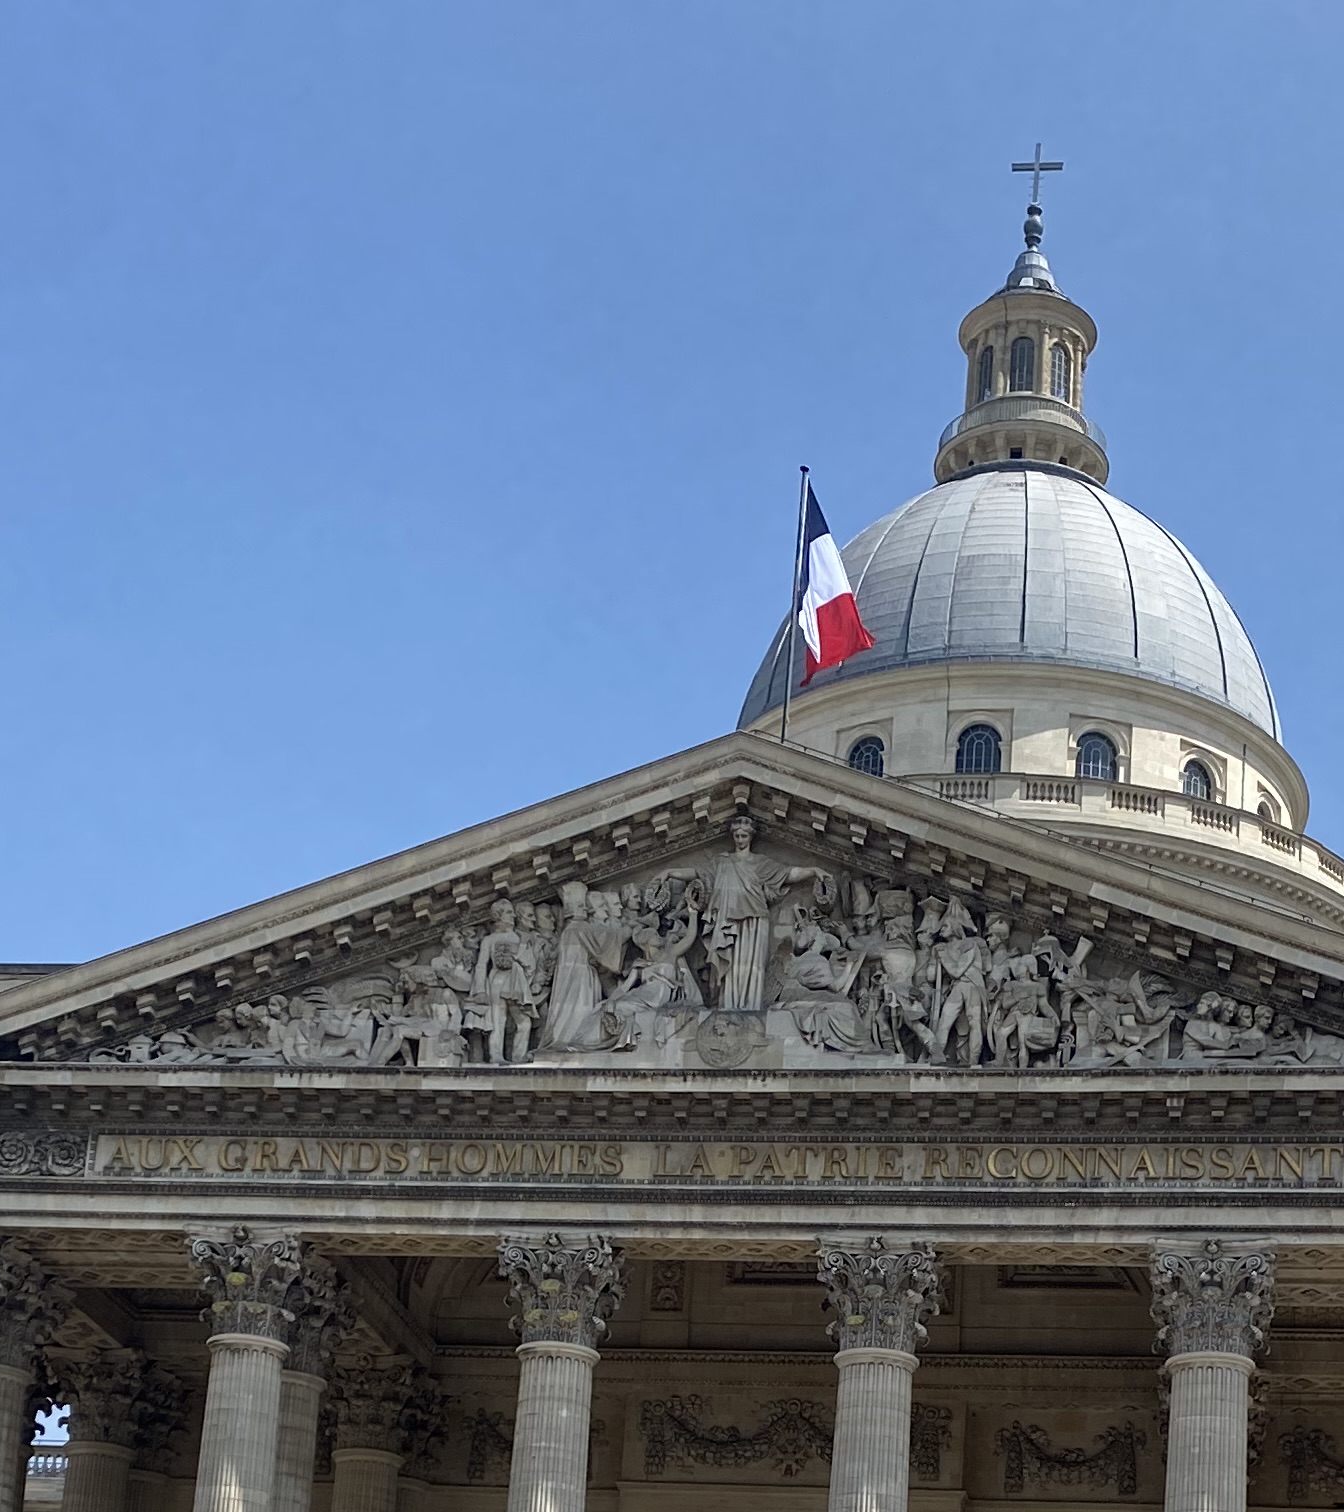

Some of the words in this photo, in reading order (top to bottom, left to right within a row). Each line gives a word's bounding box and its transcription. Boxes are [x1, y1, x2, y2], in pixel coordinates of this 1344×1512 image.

[103, 1137, 204, 1170] AUX
[217, 1138, 408, 1175] GRANDS
[418, 1142, 624, 1177] HOMMES
[653, 1143, 716, 1178] LA
[728, 1144, 903, 1179] PATRIE
